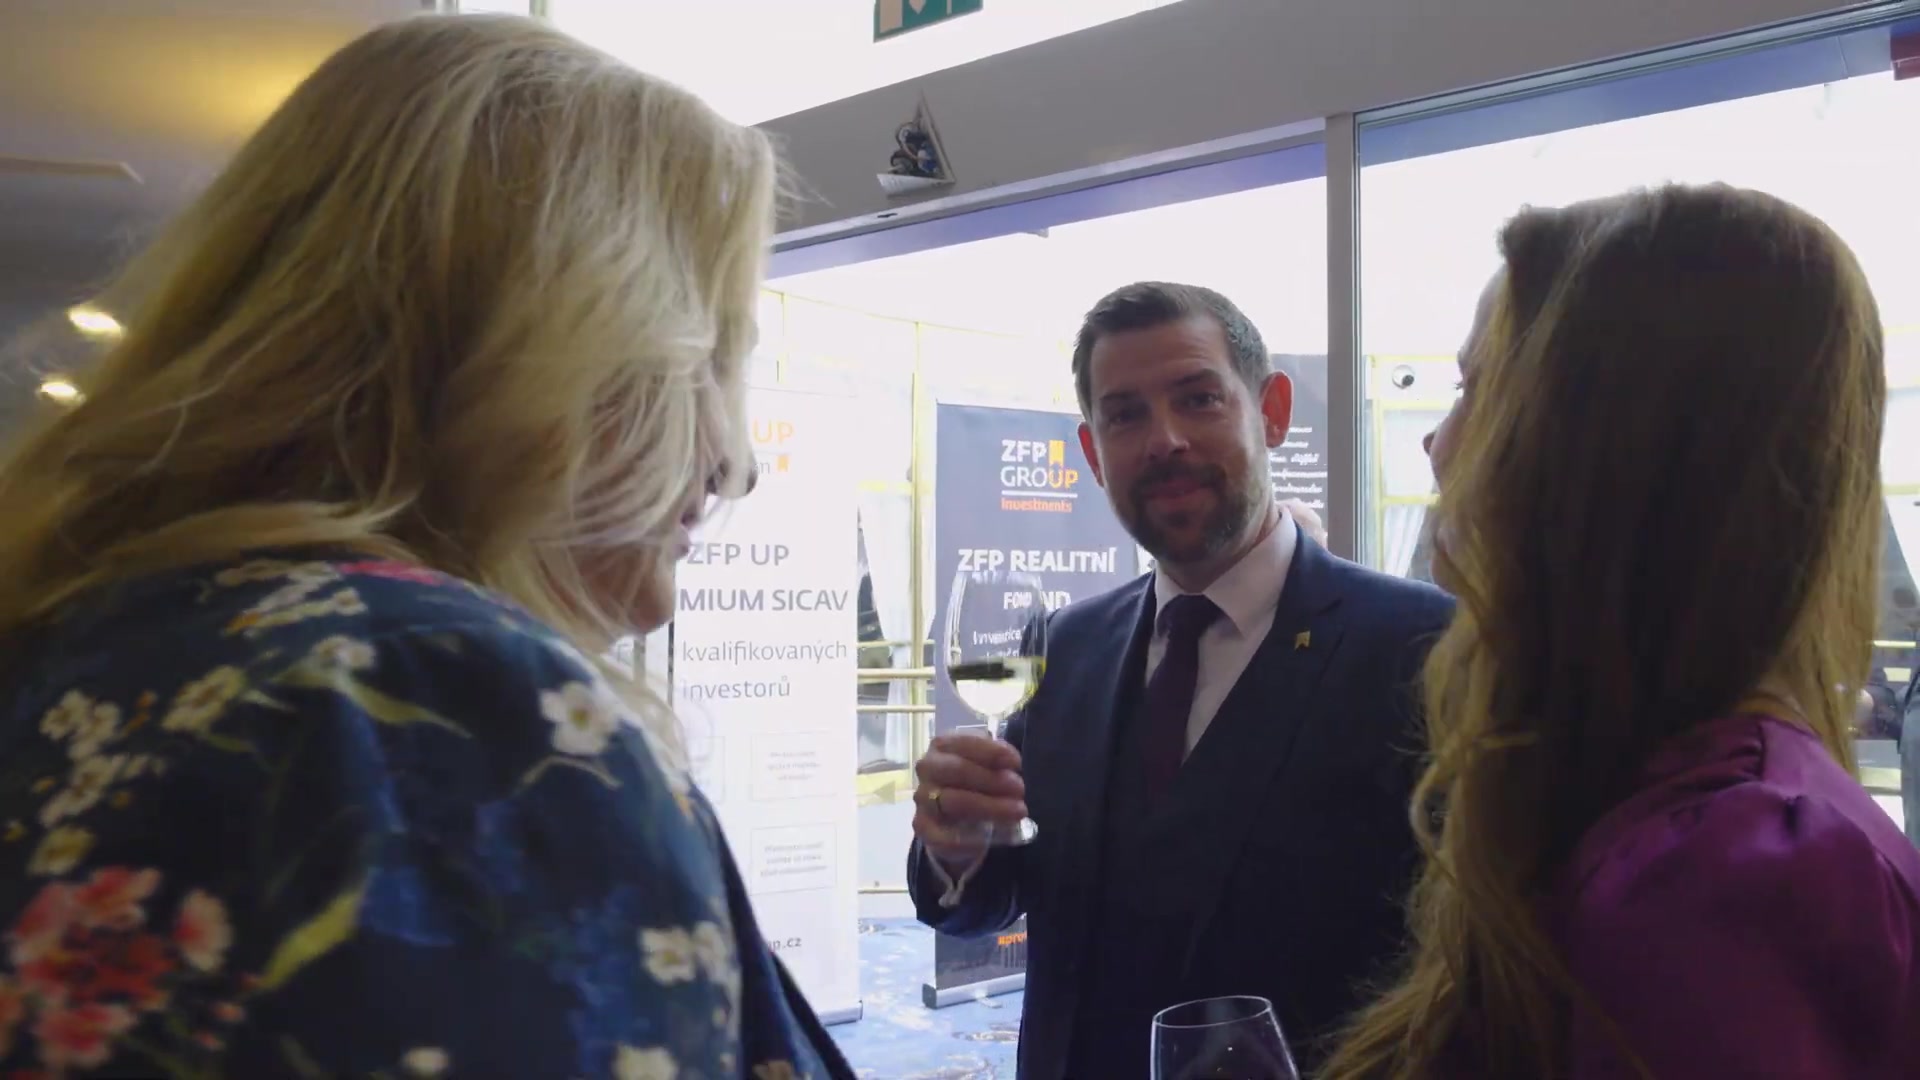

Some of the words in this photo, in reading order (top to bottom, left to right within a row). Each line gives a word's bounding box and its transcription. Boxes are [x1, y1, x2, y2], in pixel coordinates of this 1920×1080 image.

[1001, 439, 1048, 463] ZFP
[1000, 465, 1079, 489] GROUP
[687, 543, 741, 565] ZFP
[750, 544, 790, 566] UP
[957, 548, 1005, 572] ZFP
[1010, 547, 1118, 573] REALITNÍ
[679, 588, 765, 611] MIUM
[772, 588, 848, 611] SICAV
[682, 640, 848, 666] kvalifikovaných
[682, 675, 792, 699] investorů
